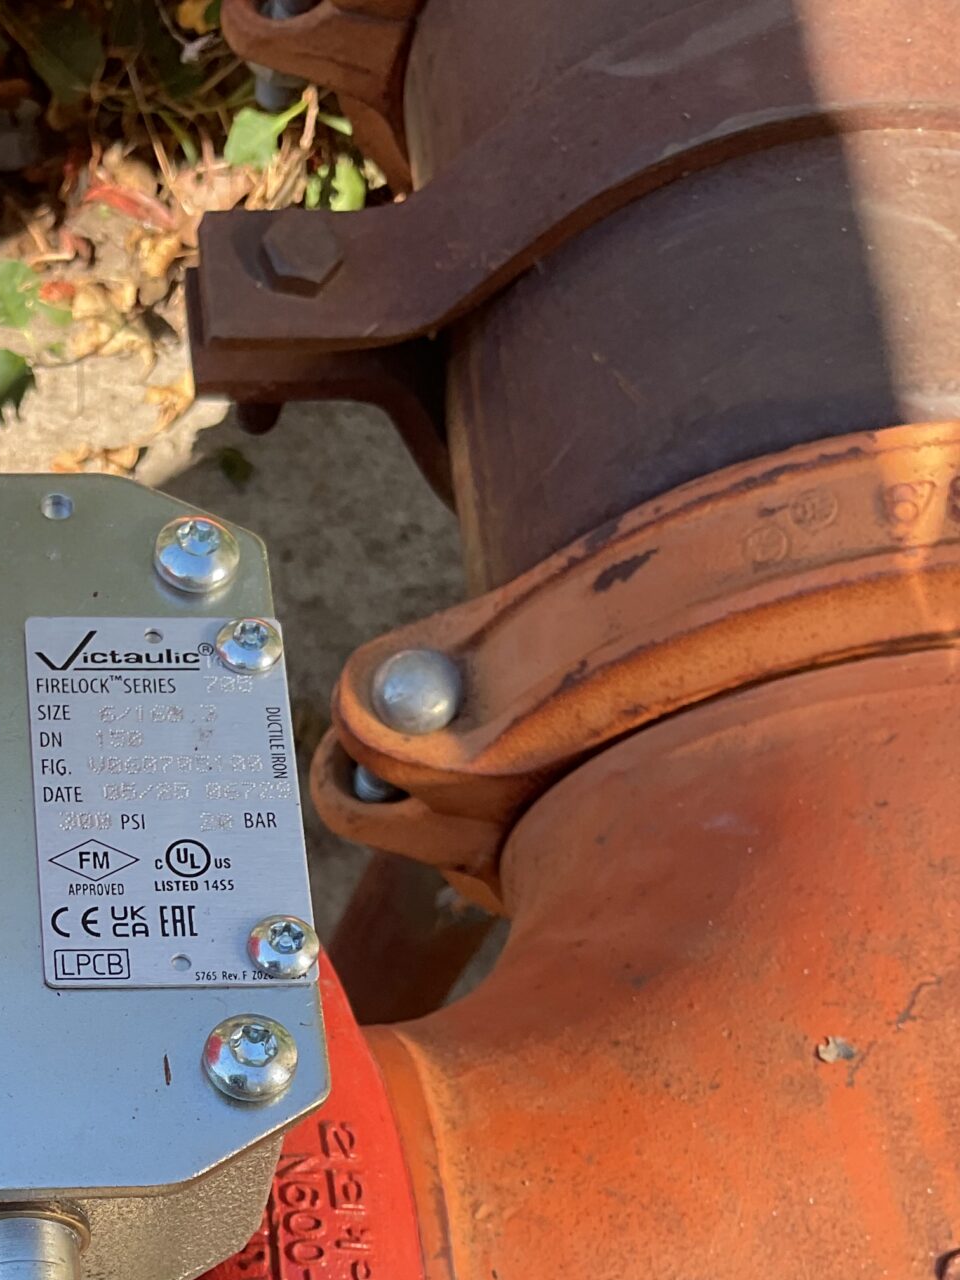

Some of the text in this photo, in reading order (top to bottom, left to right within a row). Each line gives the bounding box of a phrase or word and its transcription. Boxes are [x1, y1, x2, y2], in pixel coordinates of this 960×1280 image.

[37, 704, 72, 721] SIZE
[39, 731, 63, 748] DN
[265, 706, 289, 780] DUCTILE IRON
[41, 758, 73, 776] FIG.
[42, 785, 83, 804] DATE
[120, 813, 146, 831] PSI
[243, 811, 278, 830] BAR
[78, 850, 111, 870] FM
[67, 883, 126, 897] APPROVED
[154, 879, 200, 893] LISTED
[60, 953, 124, 977] LPCB
